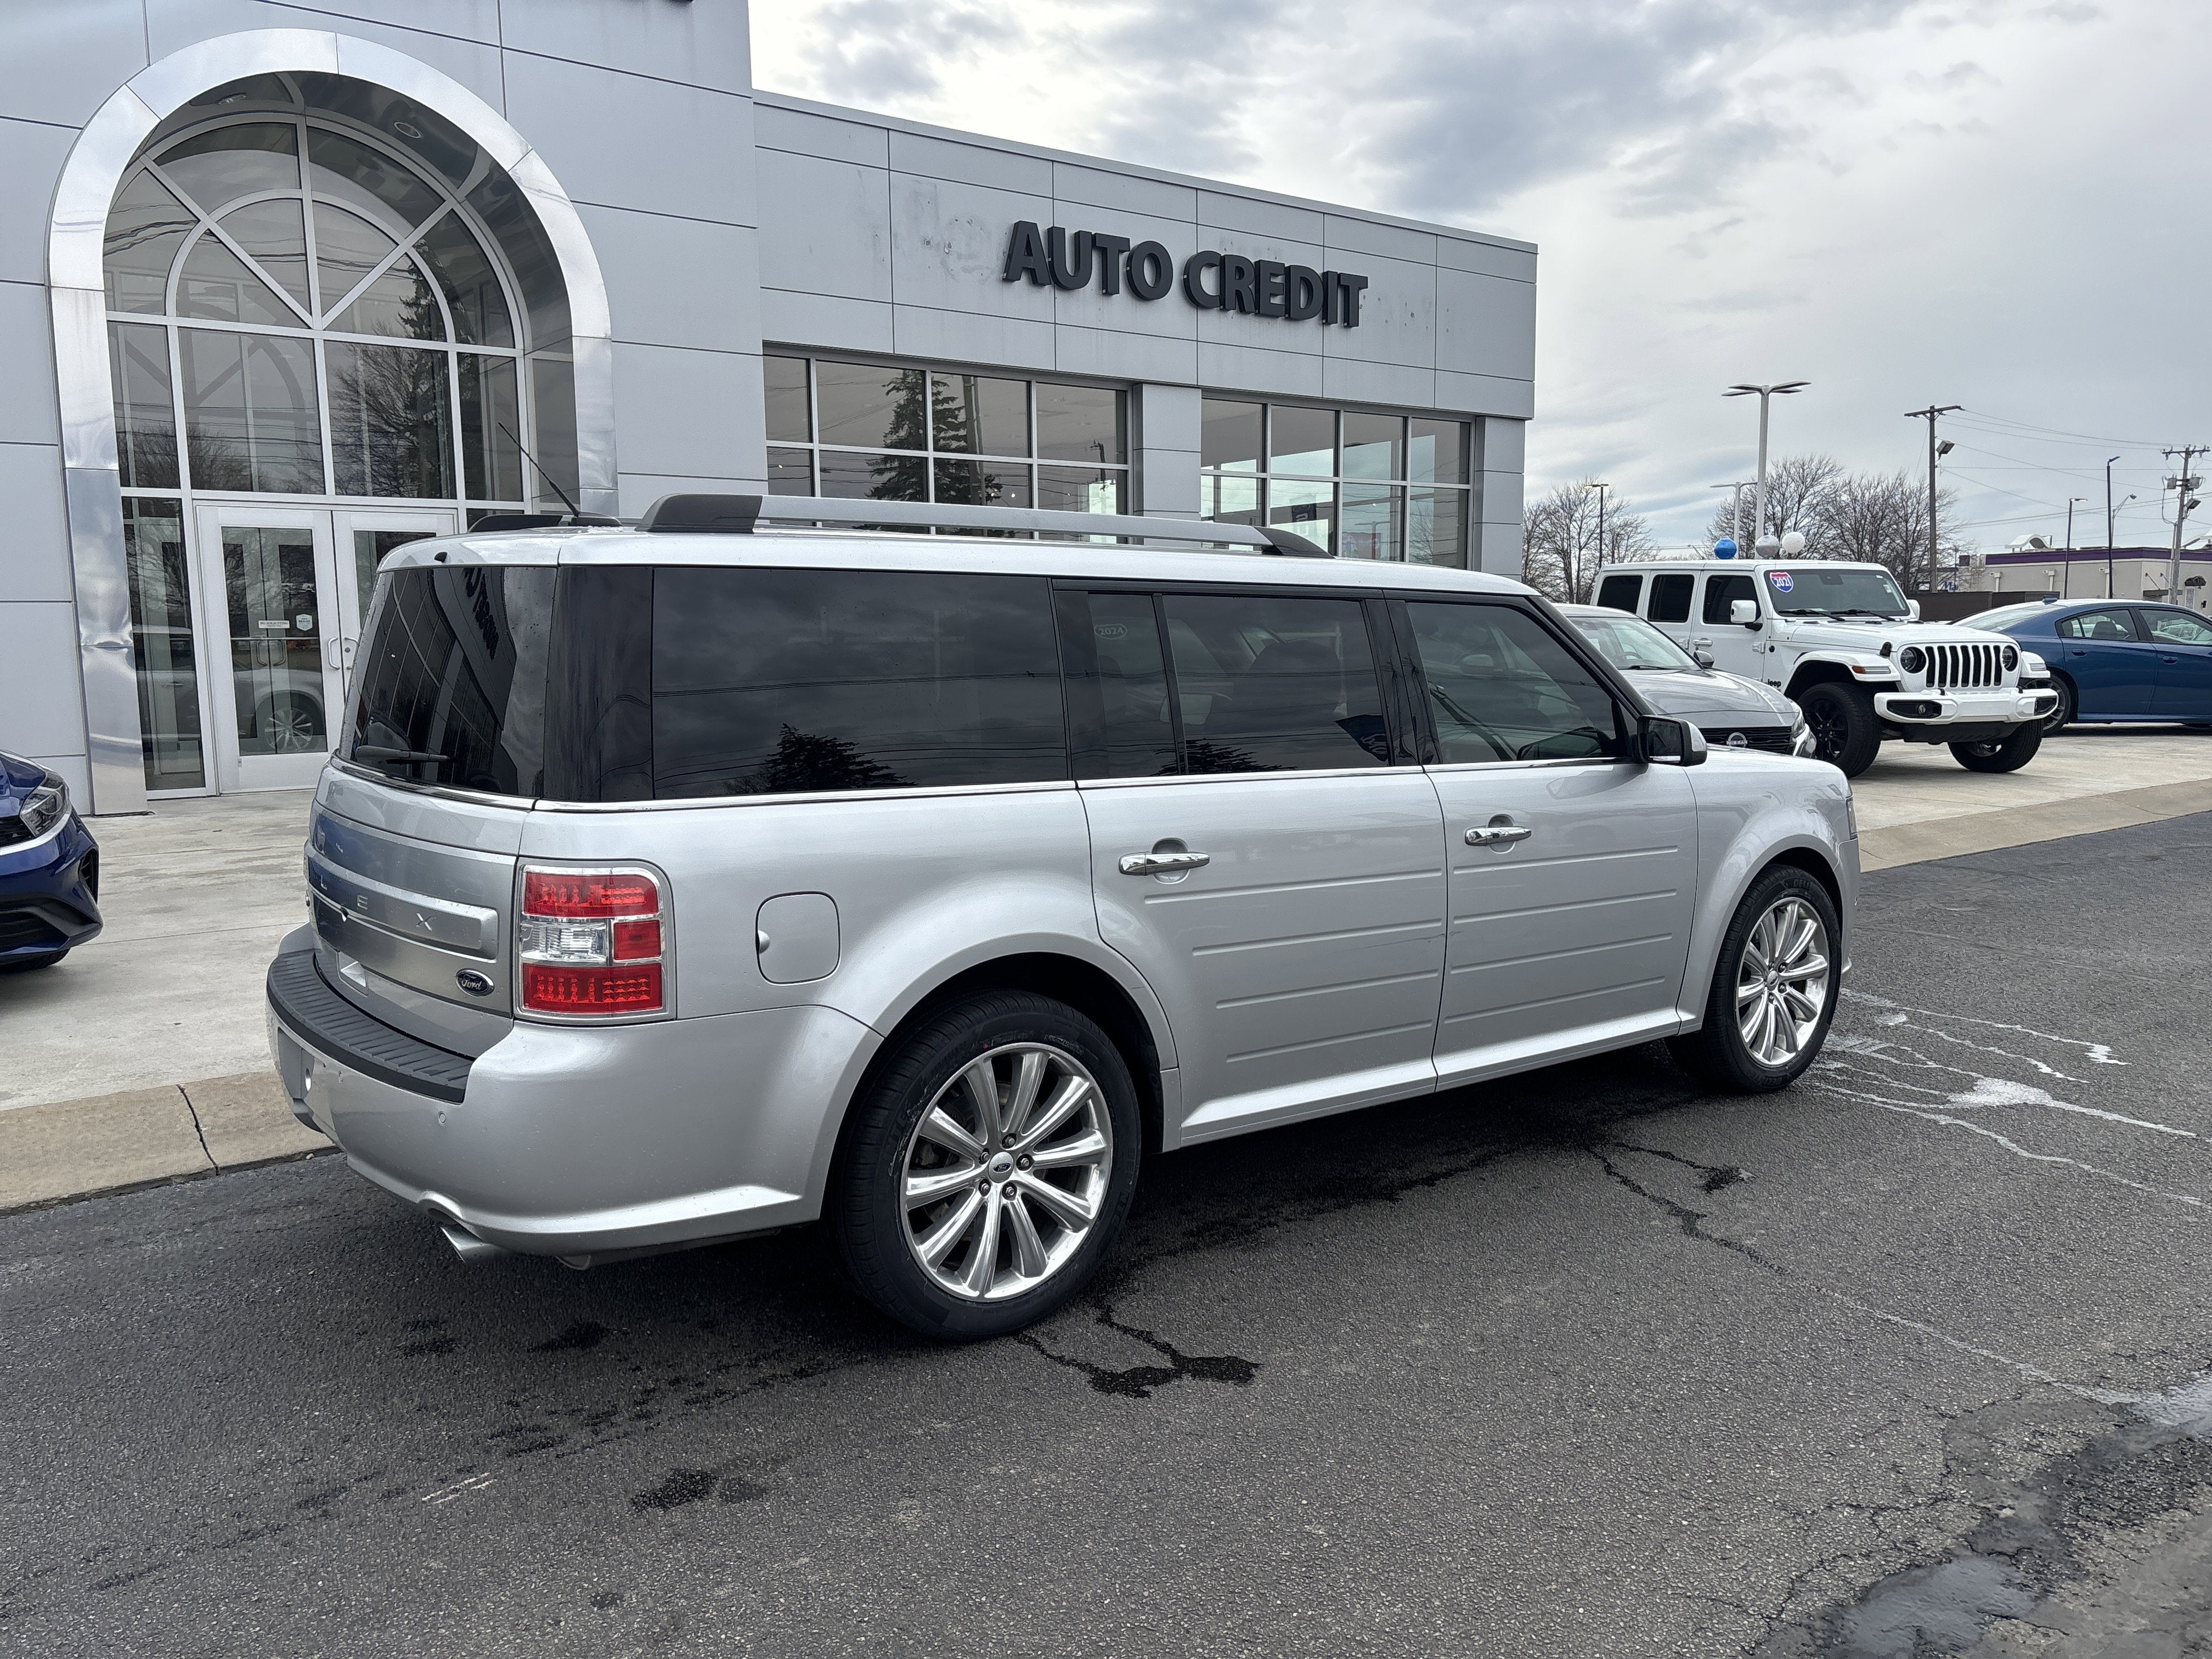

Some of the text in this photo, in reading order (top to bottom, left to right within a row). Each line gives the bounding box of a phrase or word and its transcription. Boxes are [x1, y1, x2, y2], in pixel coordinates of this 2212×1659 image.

[1002, 221, 1368, 328] AUTO CREDIT
[1773, 577, 1792, 587] 2021
[1097, 627, 1125, 635] 2024
[1764, 678, 1781, 688] Jeep
